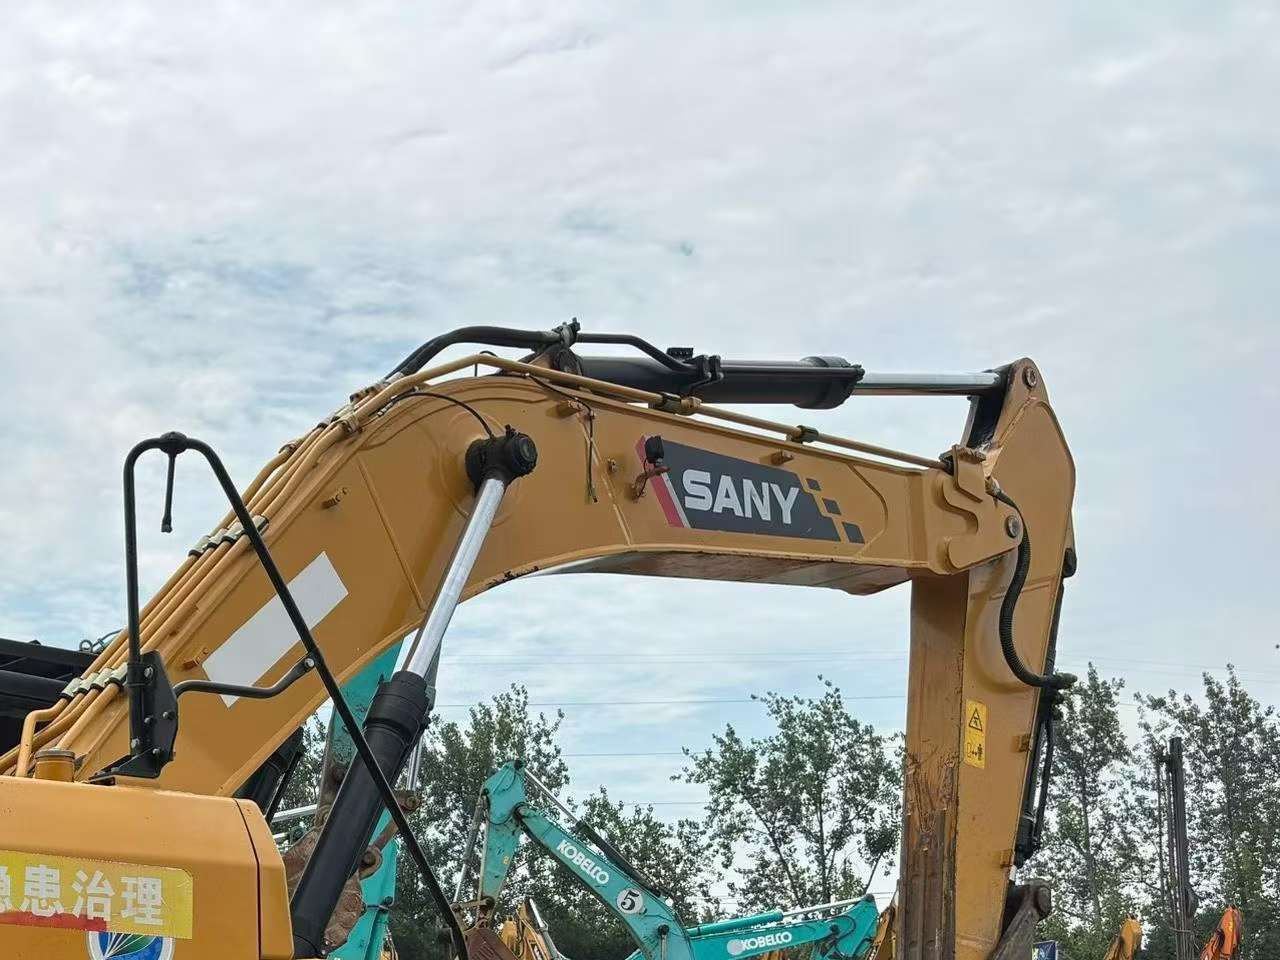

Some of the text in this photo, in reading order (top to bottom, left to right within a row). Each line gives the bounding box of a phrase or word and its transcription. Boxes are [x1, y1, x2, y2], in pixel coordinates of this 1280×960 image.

[682, 469, 800, 525] SANY
[556, 839, 610, 885] KOBELCO
[620, 889, 640, 911] 5
[740, 931, 793, 952] KOBELCO
